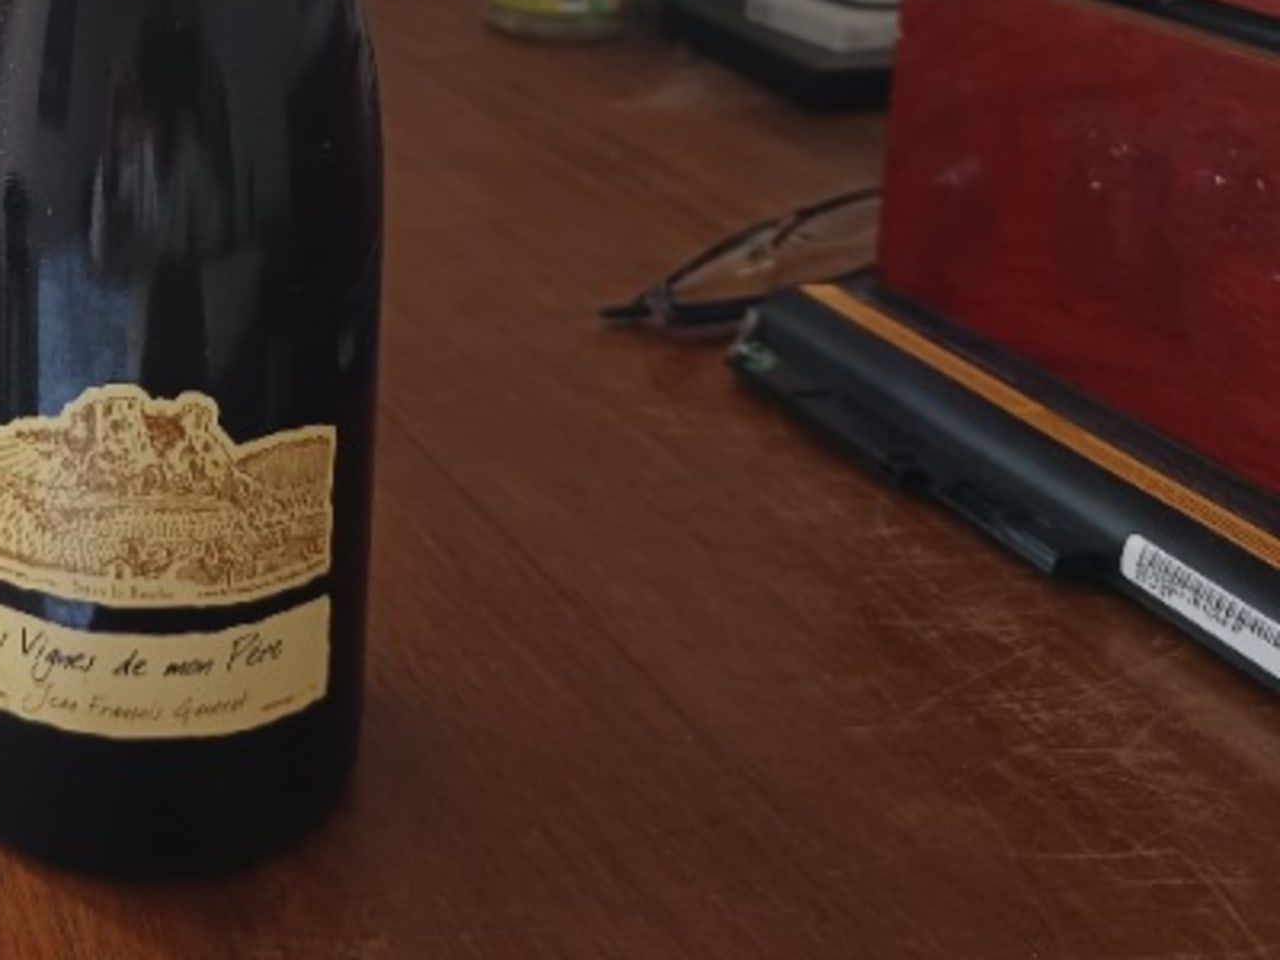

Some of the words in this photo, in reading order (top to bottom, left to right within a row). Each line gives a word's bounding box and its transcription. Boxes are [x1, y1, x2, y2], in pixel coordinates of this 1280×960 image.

[21, 626, 97, 683] Vignes
[112, 648, 148, 677] de
[162, 658, 215, 677] mon
